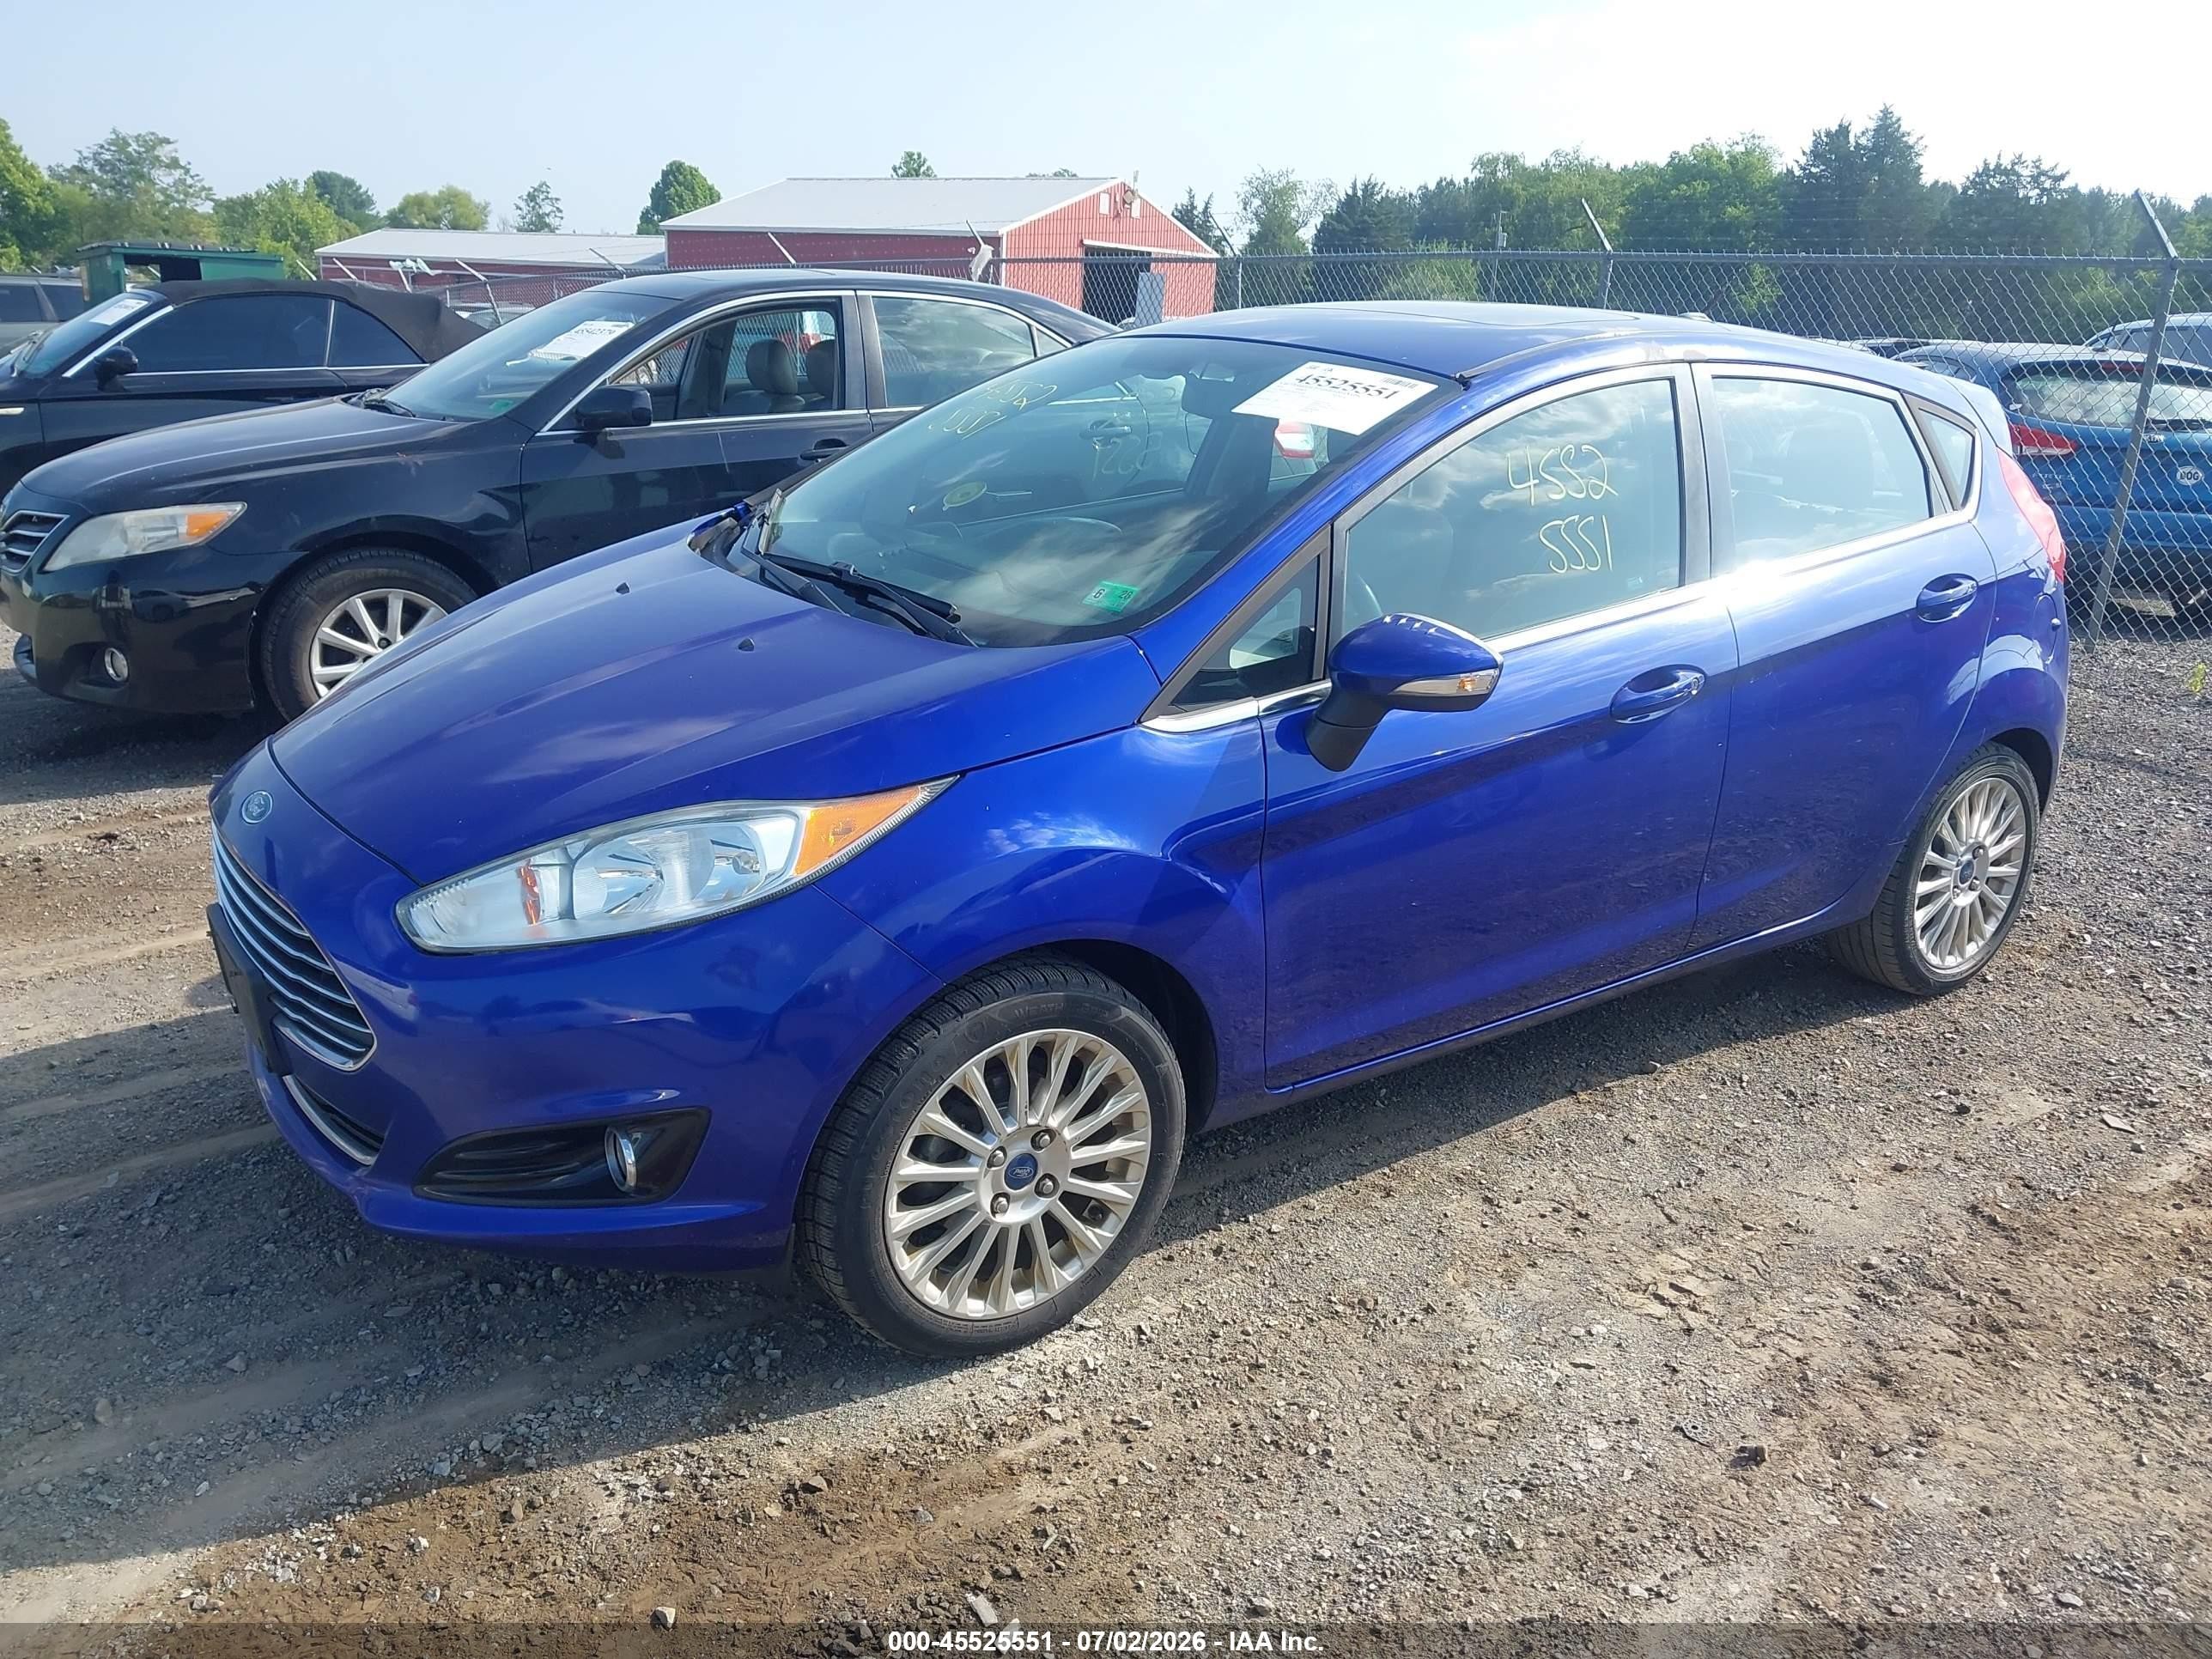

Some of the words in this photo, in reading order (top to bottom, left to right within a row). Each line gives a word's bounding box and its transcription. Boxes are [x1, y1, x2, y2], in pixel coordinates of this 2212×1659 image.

[1295, 374, 1400, 399] 45525551
[1507, 444, 1619, 506] 4552
[2179, 471, 2200, 480] DOG
[1539, 514, 1613, 574] 5551
[1093, 588, 1106, 599] 6
